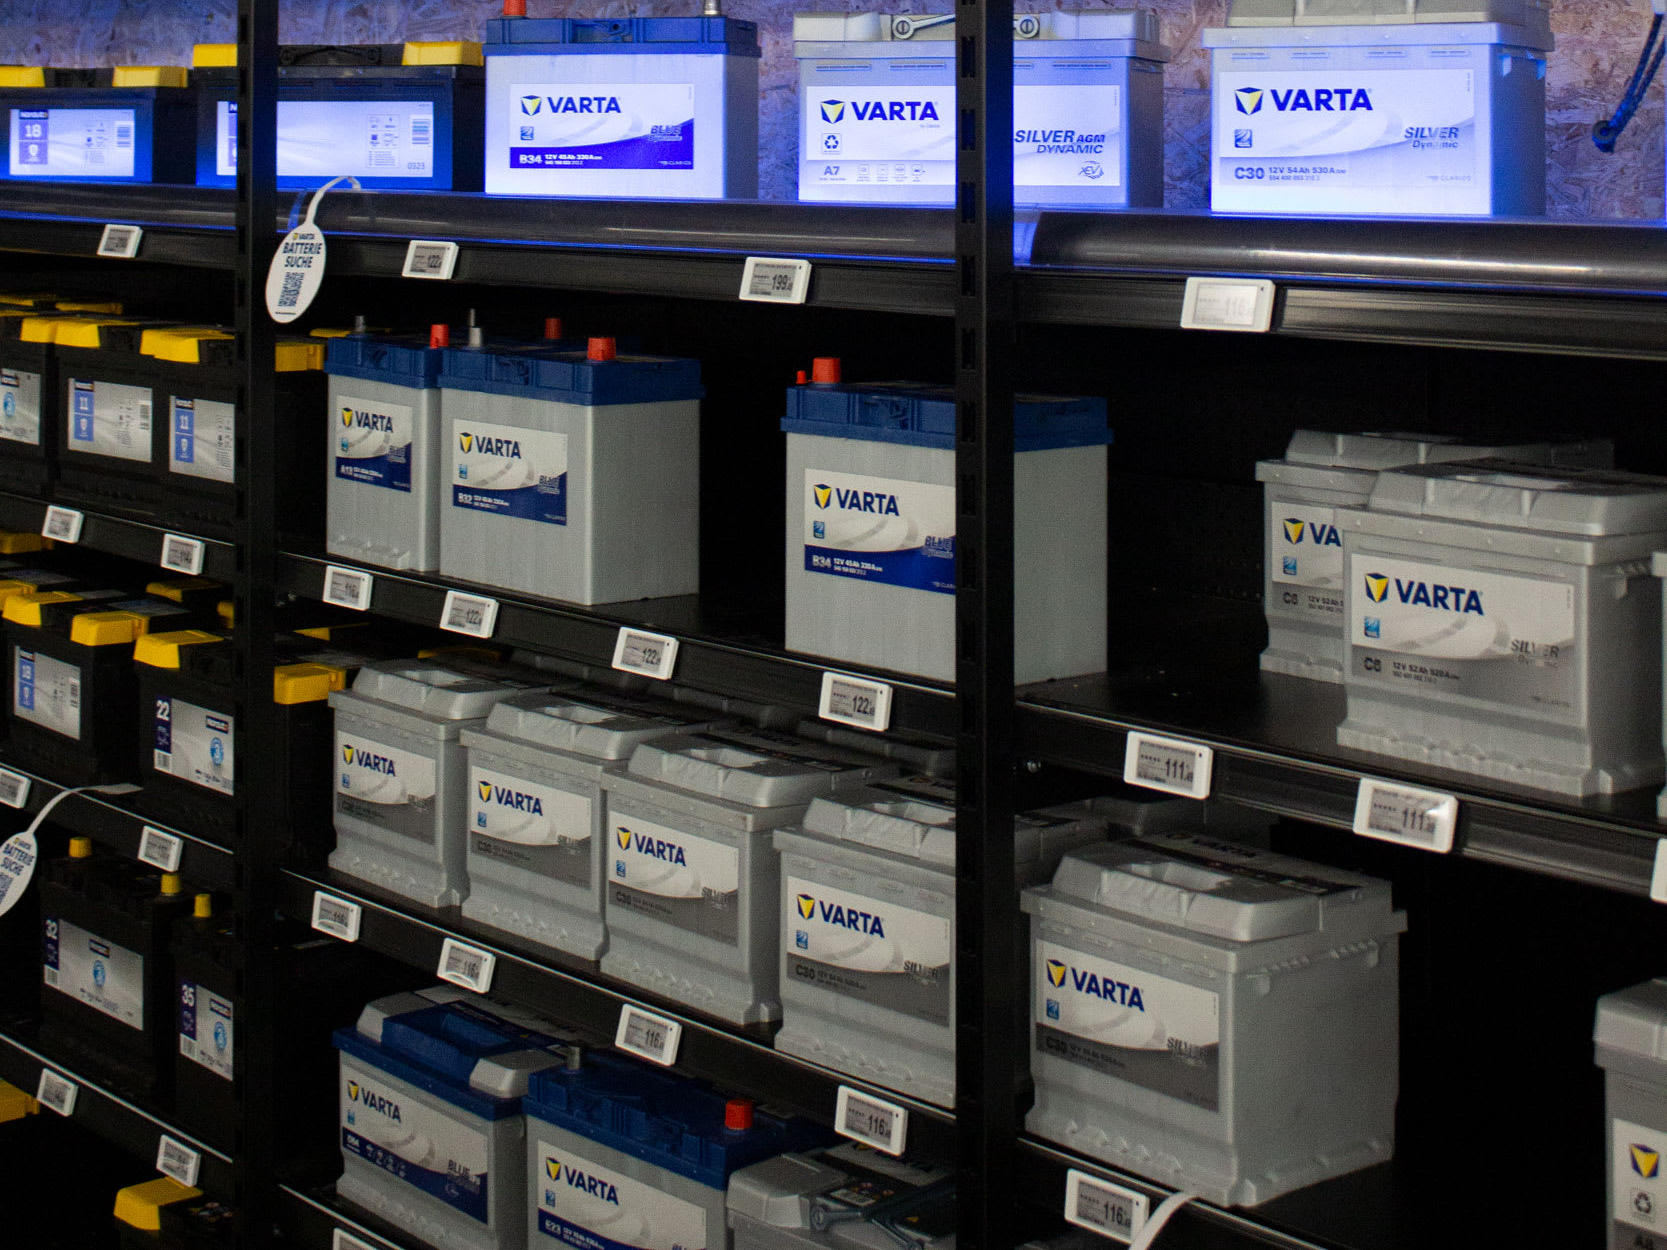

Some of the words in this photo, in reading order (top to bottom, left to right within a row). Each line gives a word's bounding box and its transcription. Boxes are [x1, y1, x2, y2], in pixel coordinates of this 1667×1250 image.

[547, 97, 621, 113] VARTA
[1271, 89, 1373, 111] VARTA
[852, 101, 939, 121] VARTA
[25, 123, 42, 138] 18
[1015, 130, 1075, 143] SILVER
[1077, 134, 1105, 143] AGM
[1404, 127, 1459, 138] SILVER
[520, 154, 542, 164] B34
[1037, 145, 1102, 154] DYNAMIC
[407, 162, 426, 170] 0323
[824, 166, 840, 175] A7
[1235, 167, 1265, 179] C30
[283, 243, 322, 254] BATTERIE
[285, 256, 313, 268] SUCHE
[355, 411, 394, 433] VARTA
[476, 436, 521, 459] VARTA
[836, 488, 899, 516] VARTA
[925, 536, 953, 550] BLUE
[1309, 522, 1342, 547] VA
[812, 555, 831, 568] B34
[1395, 578, 1484, 615] VARTA
[1511, 638, 1559, 658] SILR
[157, 700, 170, 721] 22
[356, 749, 396, 777] VARTA
[494, 785, 543, 816] VARTA
[634, 832, 687, 867] VARTA
[819, 900, 885, 938] VARTA
[1071, 967, 1145, 1012] VARTA
[361, 1087, 401, 1123] VARTA
[565, 1165, 619, 1205] VARTA
